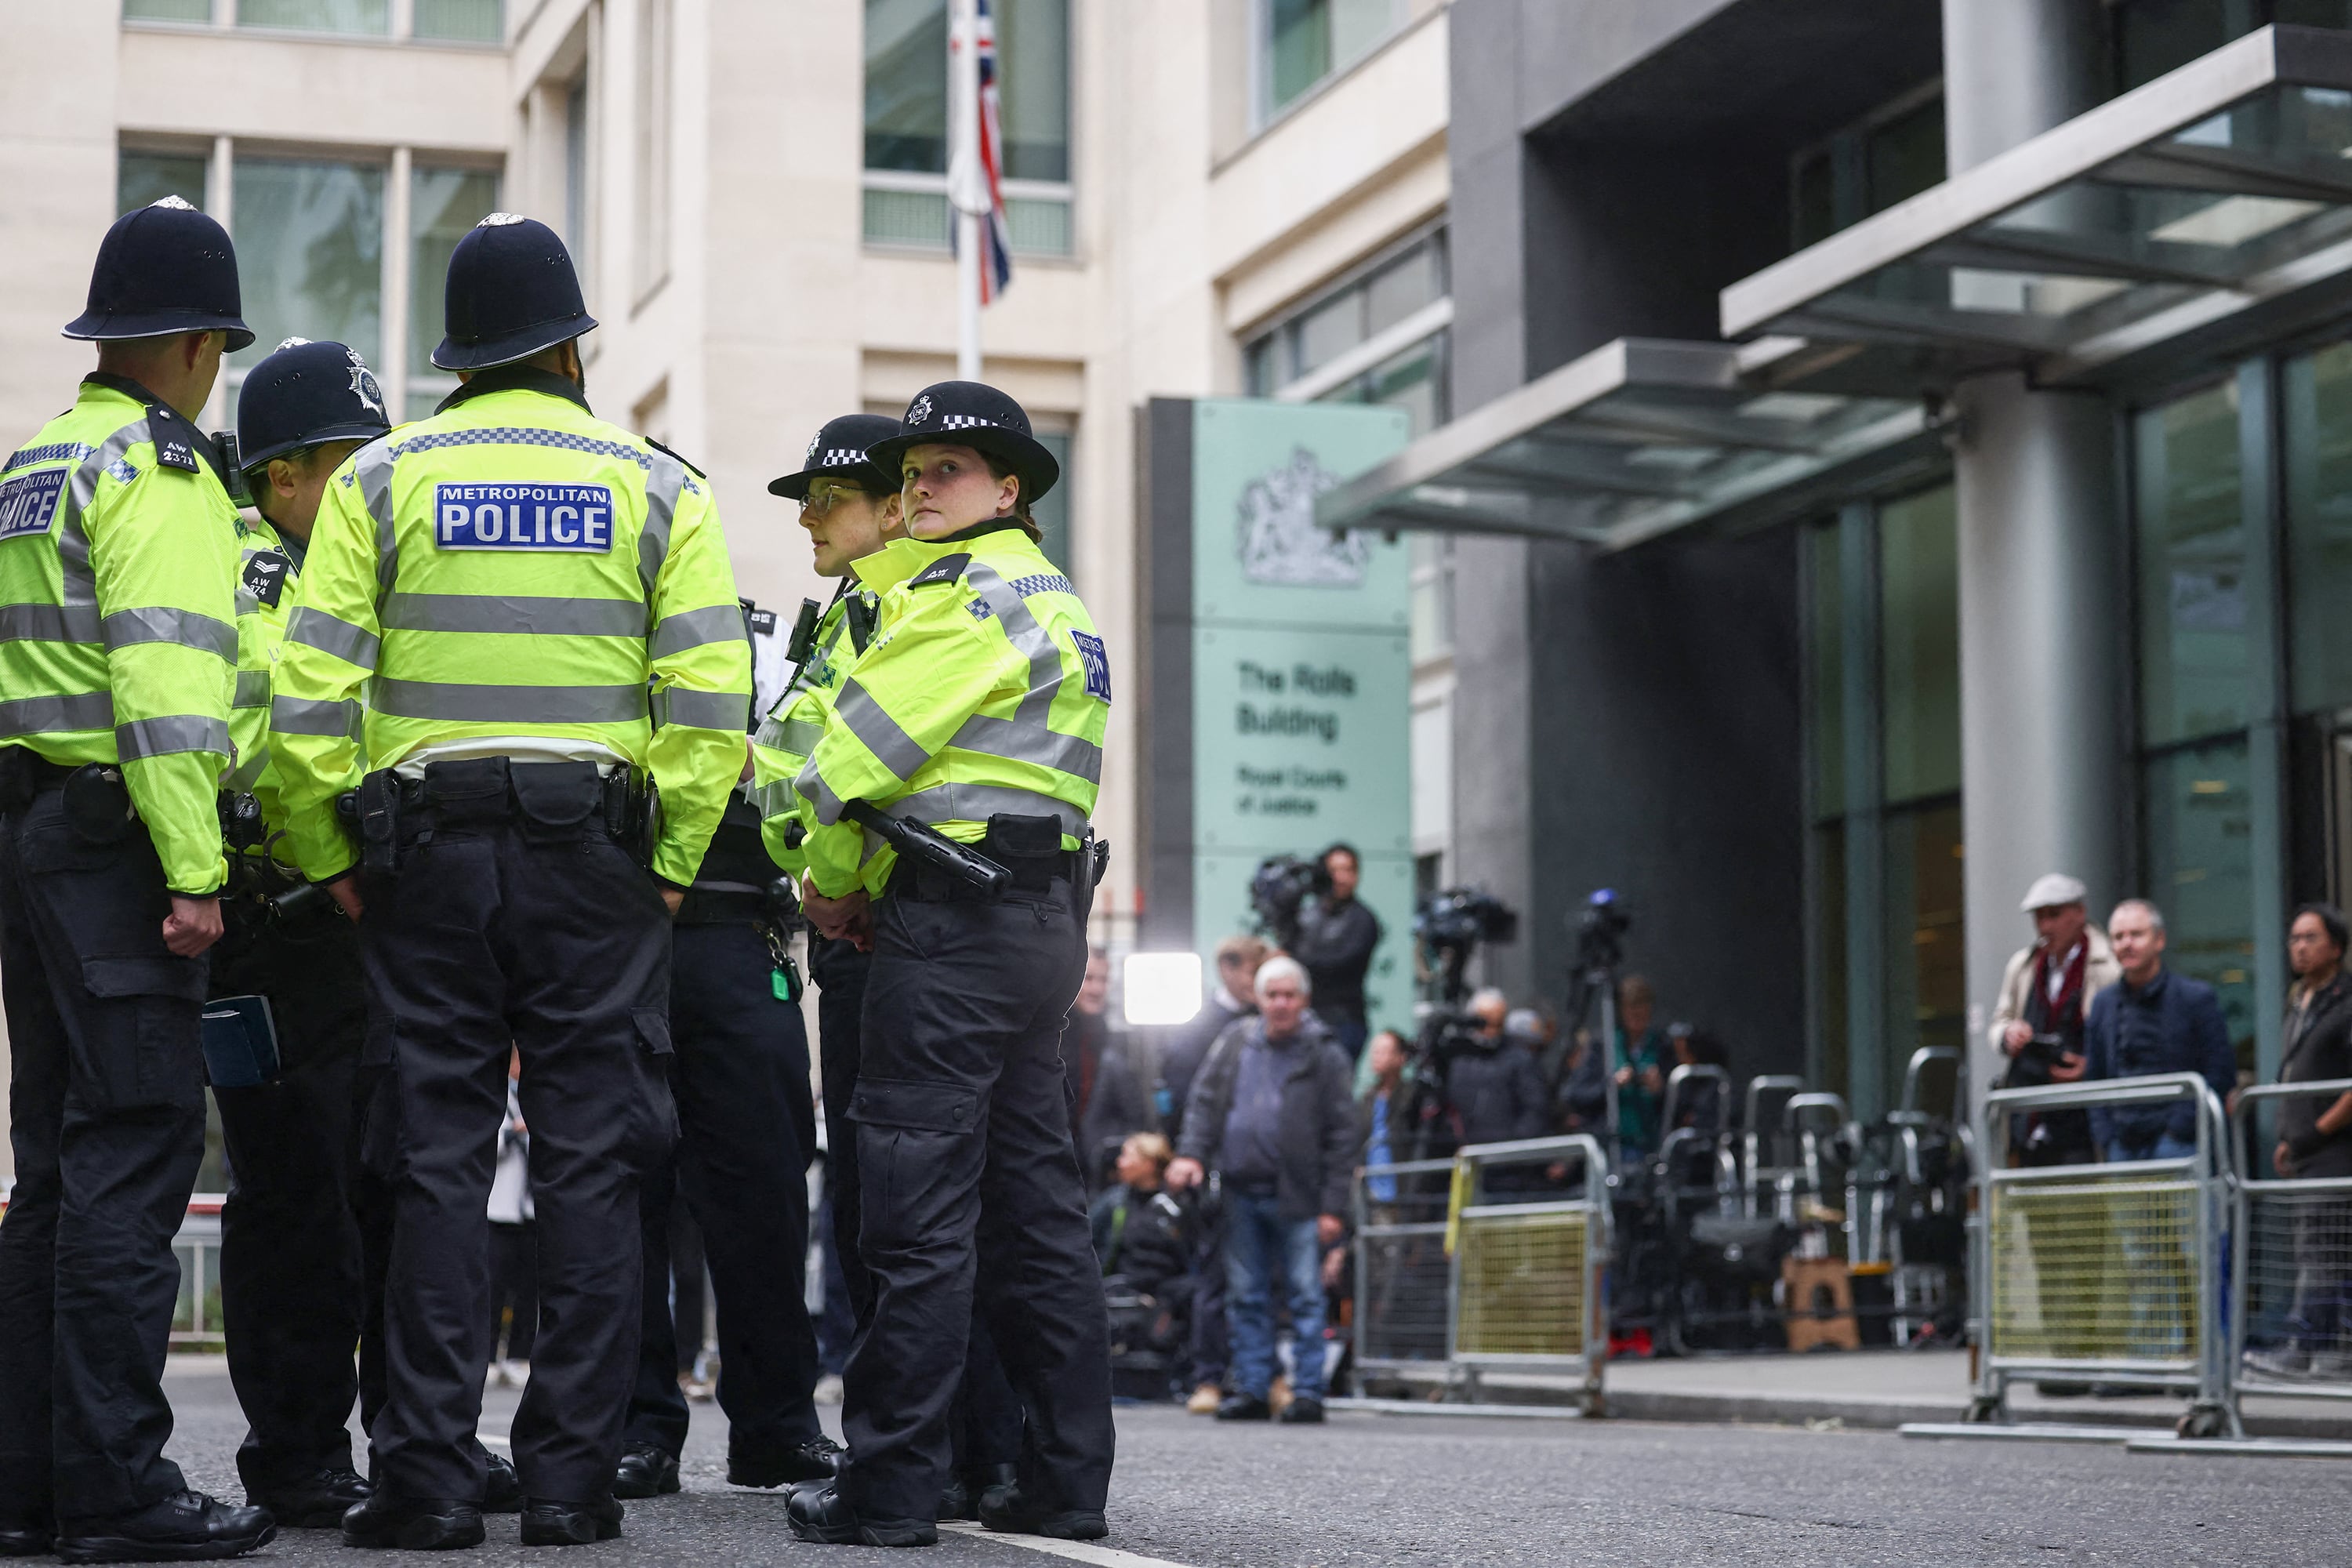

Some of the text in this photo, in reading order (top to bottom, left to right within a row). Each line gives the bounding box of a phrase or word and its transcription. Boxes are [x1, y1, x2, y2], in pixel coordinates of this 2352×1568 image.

[167, 441, 187, 453] AW
[163, 451, 194, 466] 2371
[0, 473, 63, 499] ETROOLITAN
[442, 488, 607, 503] METROPOLITAN
[0, 490, 57, 534] OLICE
[441, 504, 607, 545] POLICE
[251, 576, 270, 586] AW
